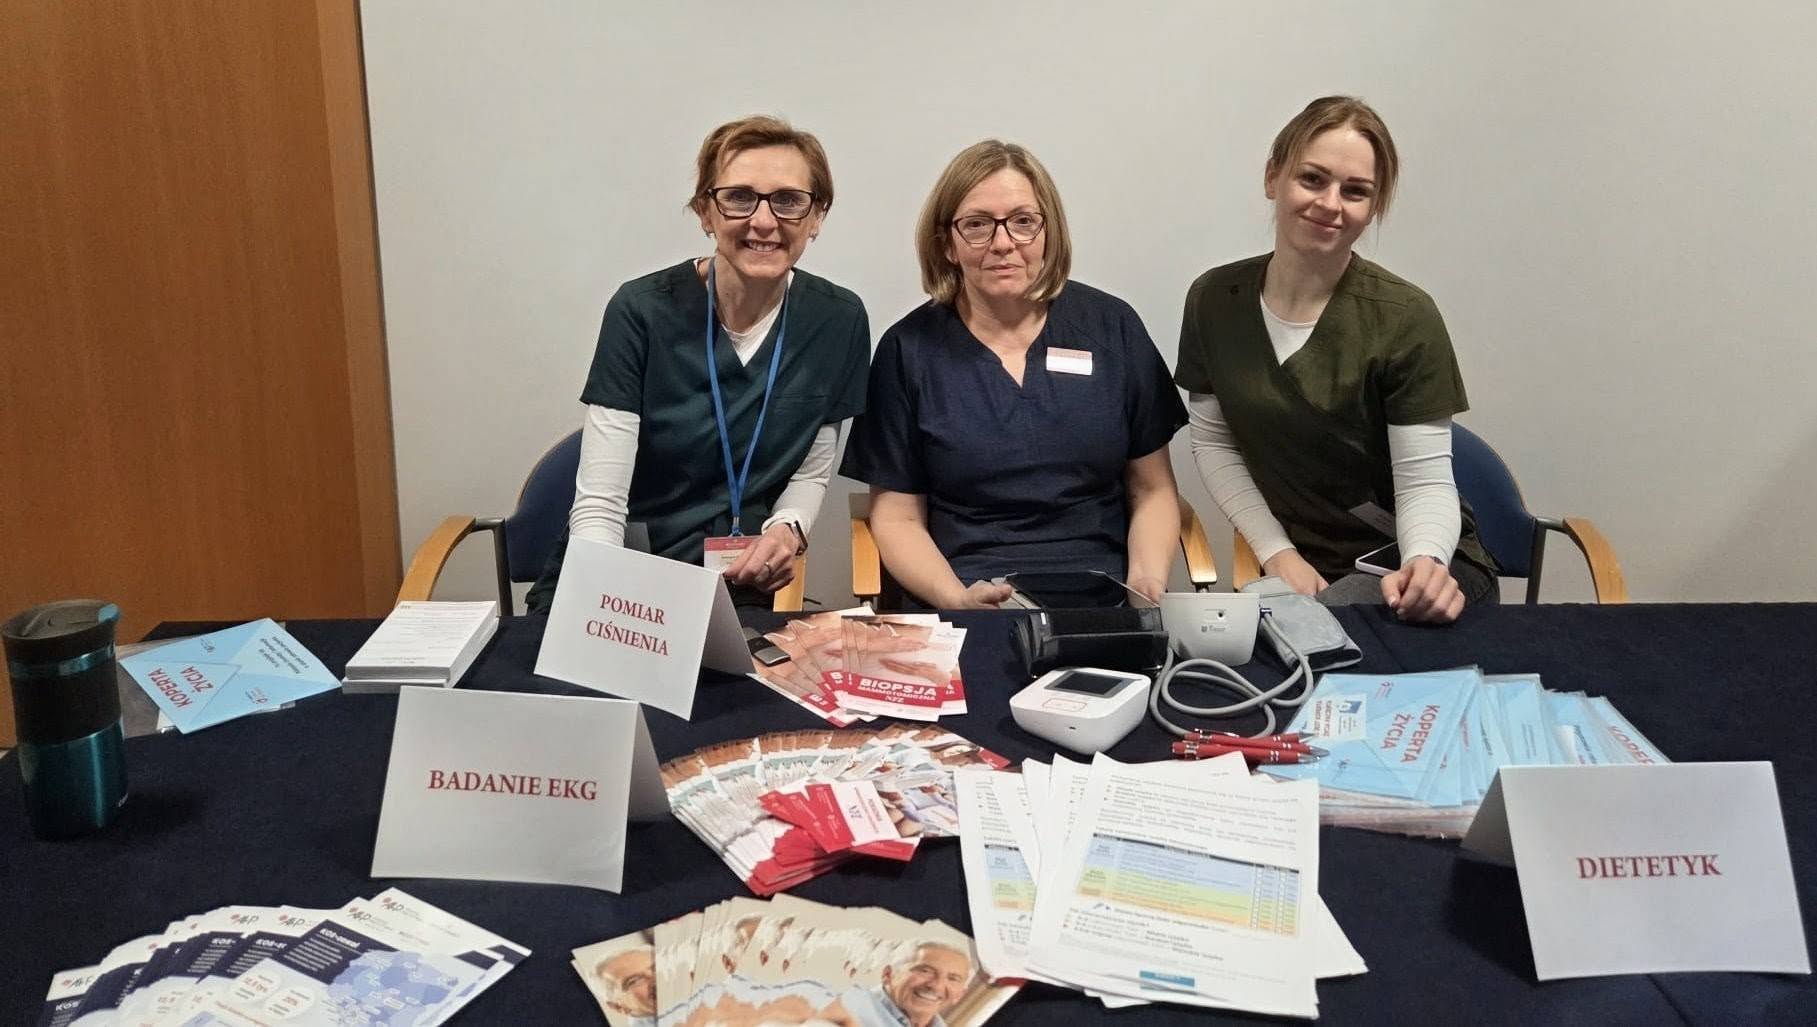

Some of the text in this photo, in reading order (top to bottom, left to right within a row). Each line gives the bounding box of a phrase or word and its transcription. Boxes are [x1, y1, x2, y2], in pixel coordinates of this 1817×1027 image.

[600, 594, 665, 625] POMIAR
[586, 620, 669, 656] CIŚNIENIA
[147, 667, 193, 709] KOPERTA
[859, 678, 938, 697] BIOPSJA
[1380, 712, 1415, 749] ŻYCIA
[1400, 704, 1441, 763] KOPERTA
[428, 770, 598, 801] BADANIE EKG
[1576, 854, 1723, 879] DIETETYK
